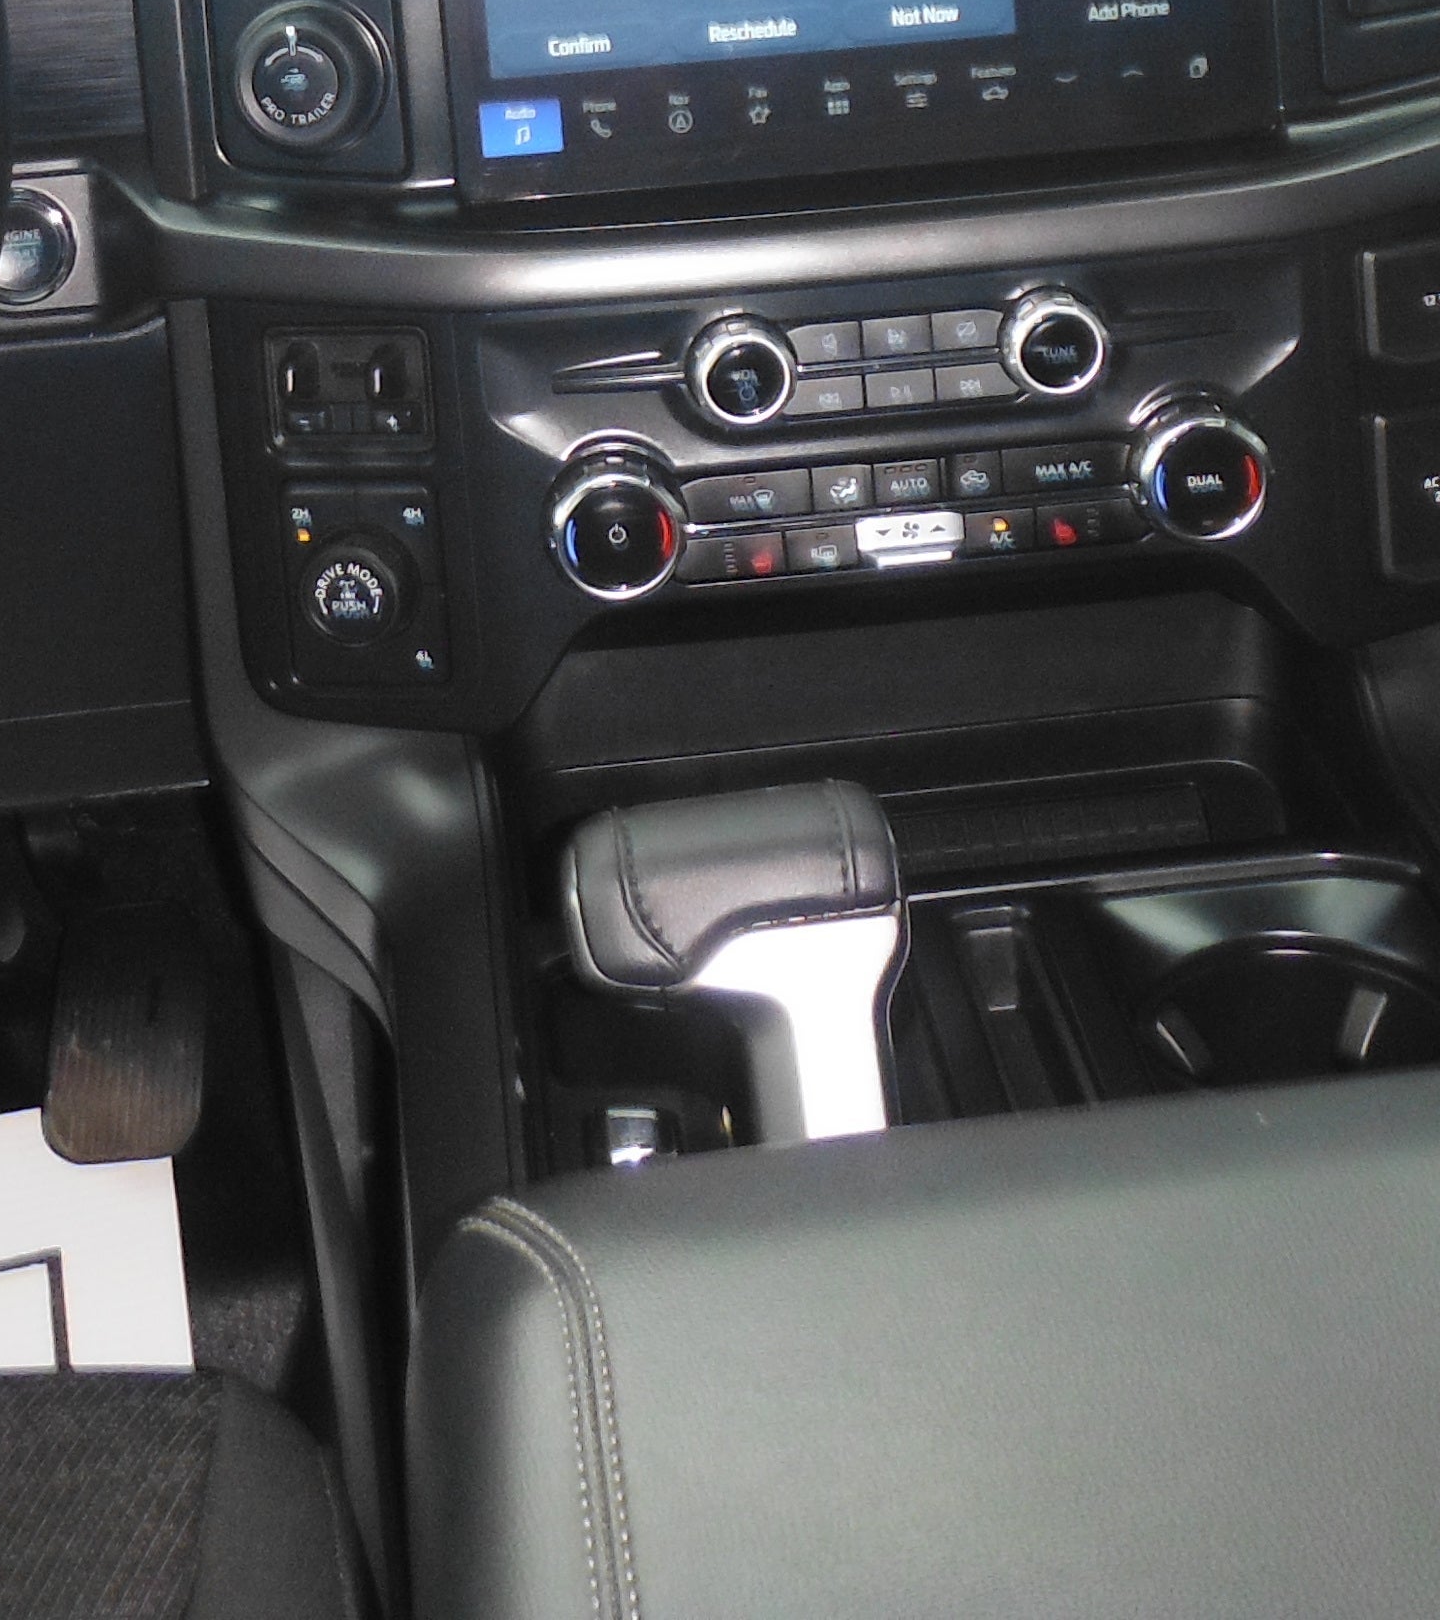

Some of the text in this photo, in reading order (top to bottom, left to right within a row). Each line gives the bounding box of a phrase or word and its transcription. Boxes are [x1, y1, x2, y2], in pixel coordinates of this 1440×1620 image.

[891, 3, 960, 28] Not Now
[1088, 2, 1117, 22] Add
[707, 19, 798, 44] Reschedule
[547, 35, 612, 58] Confirm
[261, 91, 336, 126] PRO TRAILER
[1035, 463, 1065, 478] MAX
[1187, 474, 1223, 487] DUAL
[890, 477, 928, 490] AUTO
[314, 562, 383, 599] DRIVE MODE
[331, 600, 367, 611] PUSH
